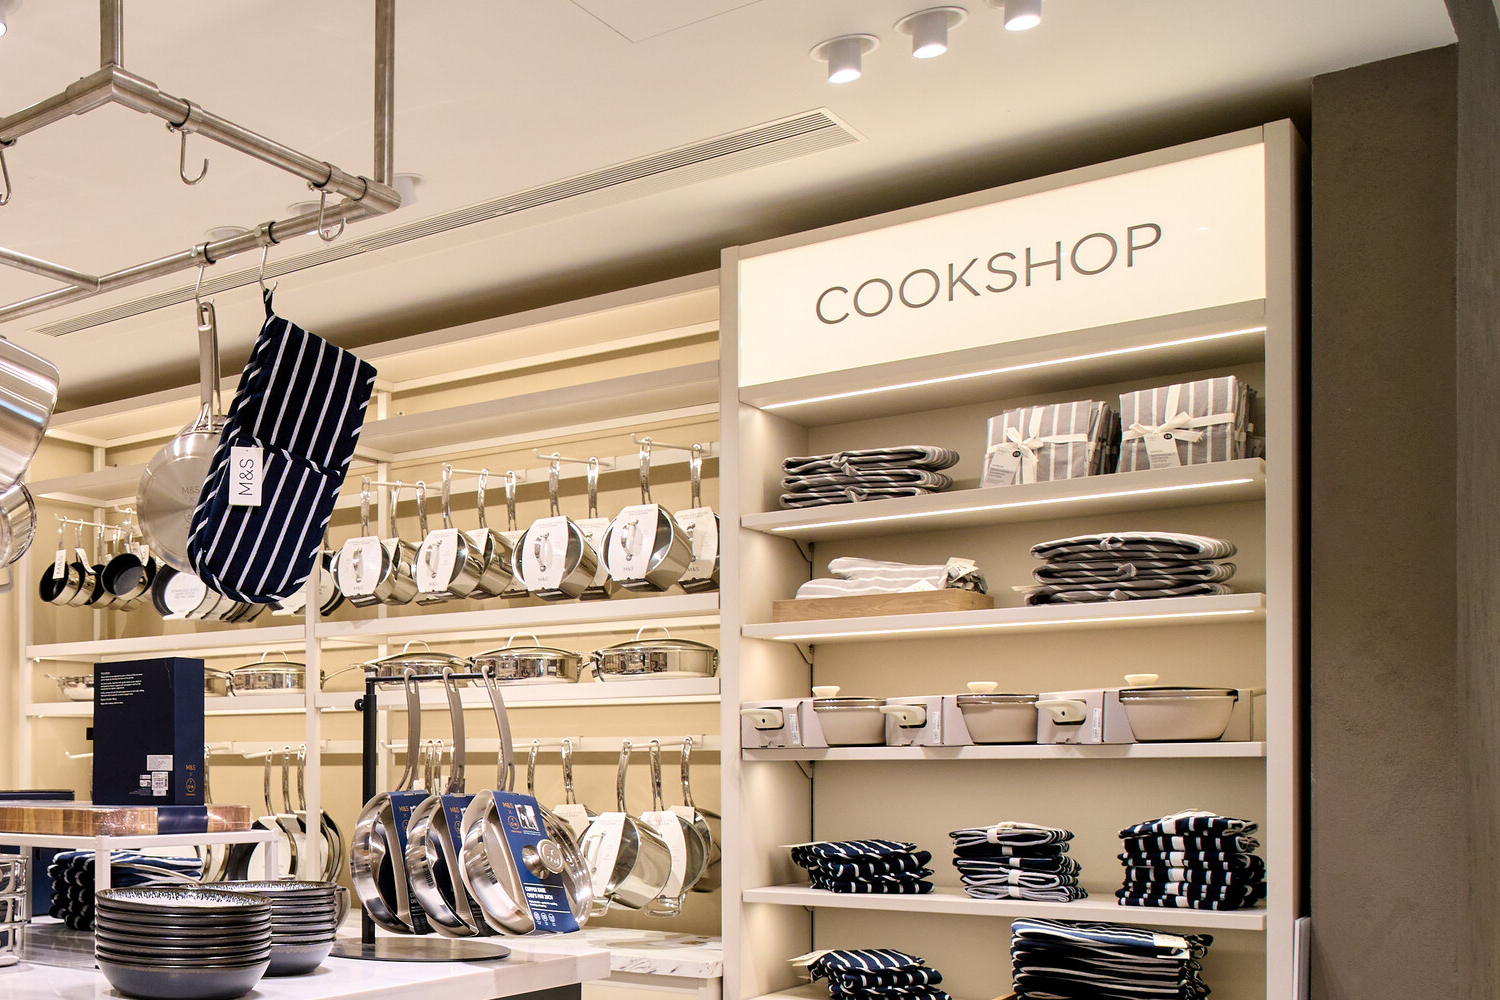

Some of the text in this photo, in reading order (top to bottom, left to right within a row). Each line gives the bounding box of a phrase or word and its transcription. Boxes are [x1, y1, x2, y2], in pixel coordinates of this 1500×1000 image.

[815, 222, 1163, 325] COOKSHOP
[181, 486, 200, 495] M&S
[238, 459, 255, 496] M&S
